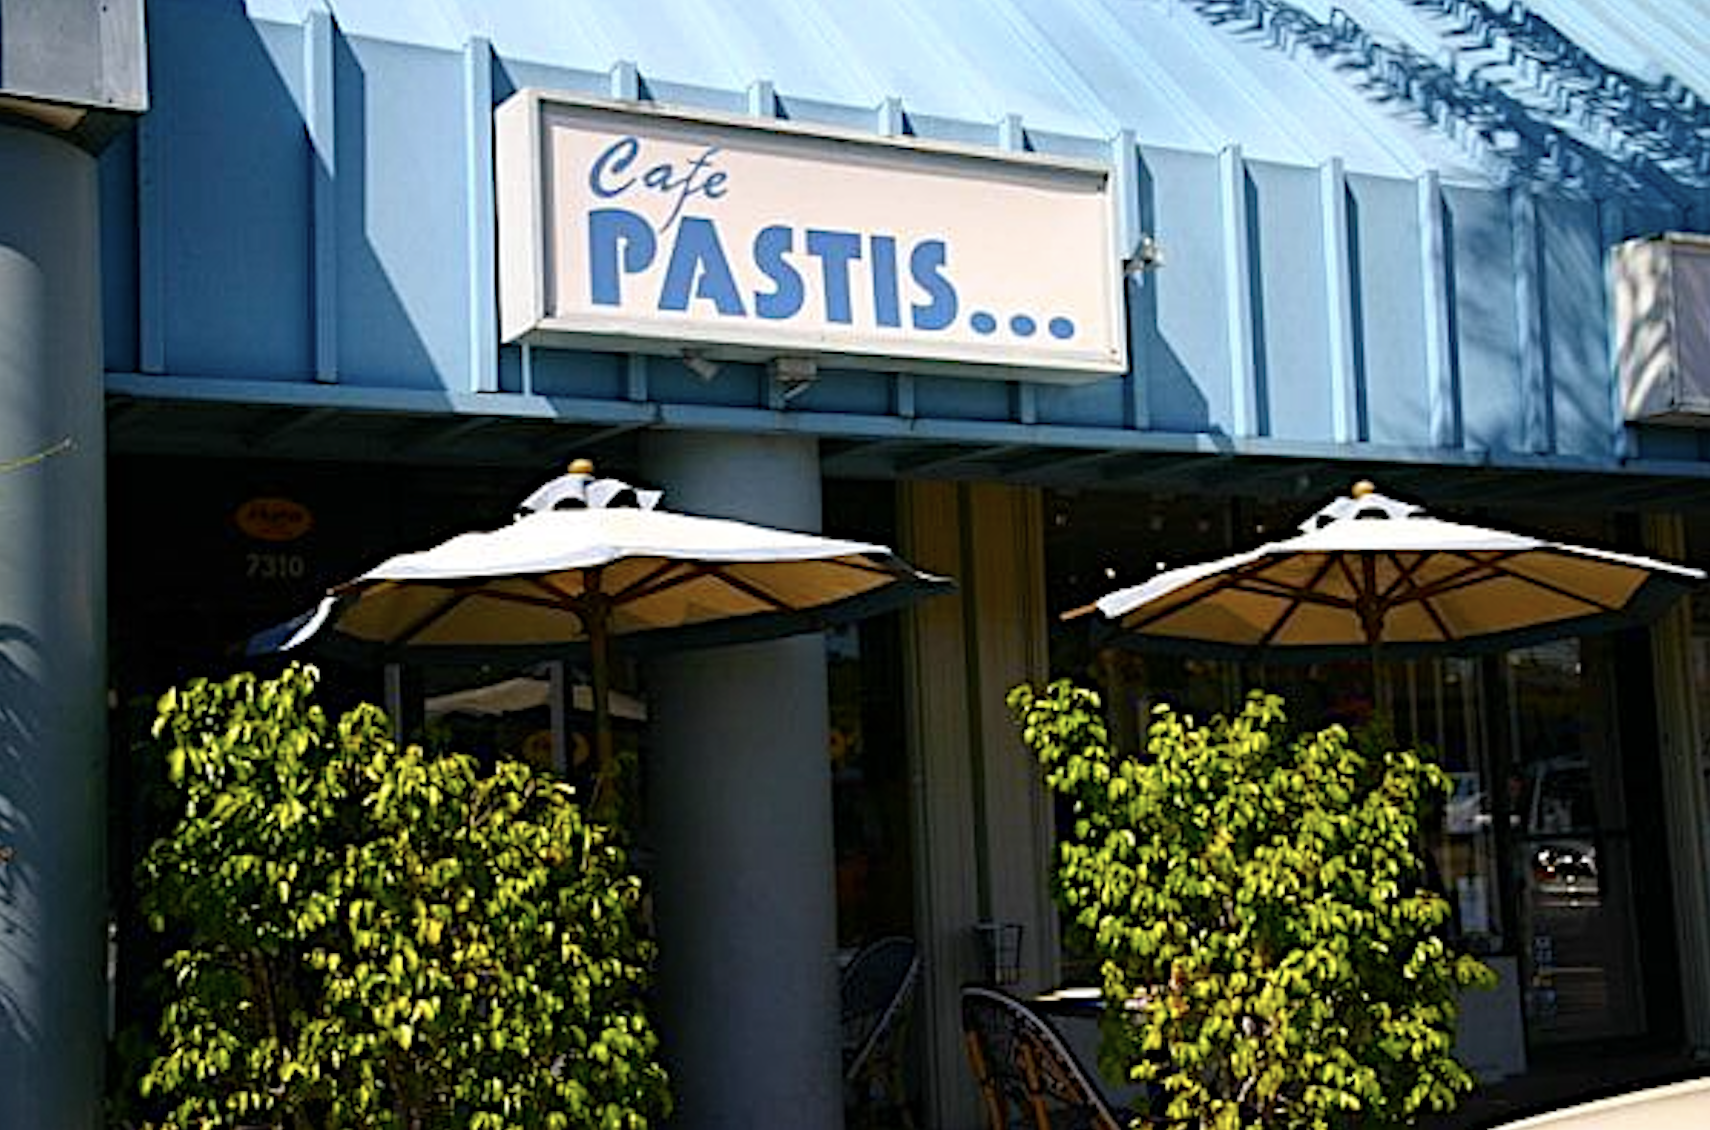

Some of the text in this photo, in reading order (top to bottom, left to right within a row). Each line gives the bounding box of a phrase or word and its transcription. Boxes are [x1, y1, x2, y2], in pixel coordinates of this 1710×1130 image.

[588, 135, 728, 233] Cafe
[587, 209, 1076, 339] PASTIS...
[245, 553, 305, 579] 7310
